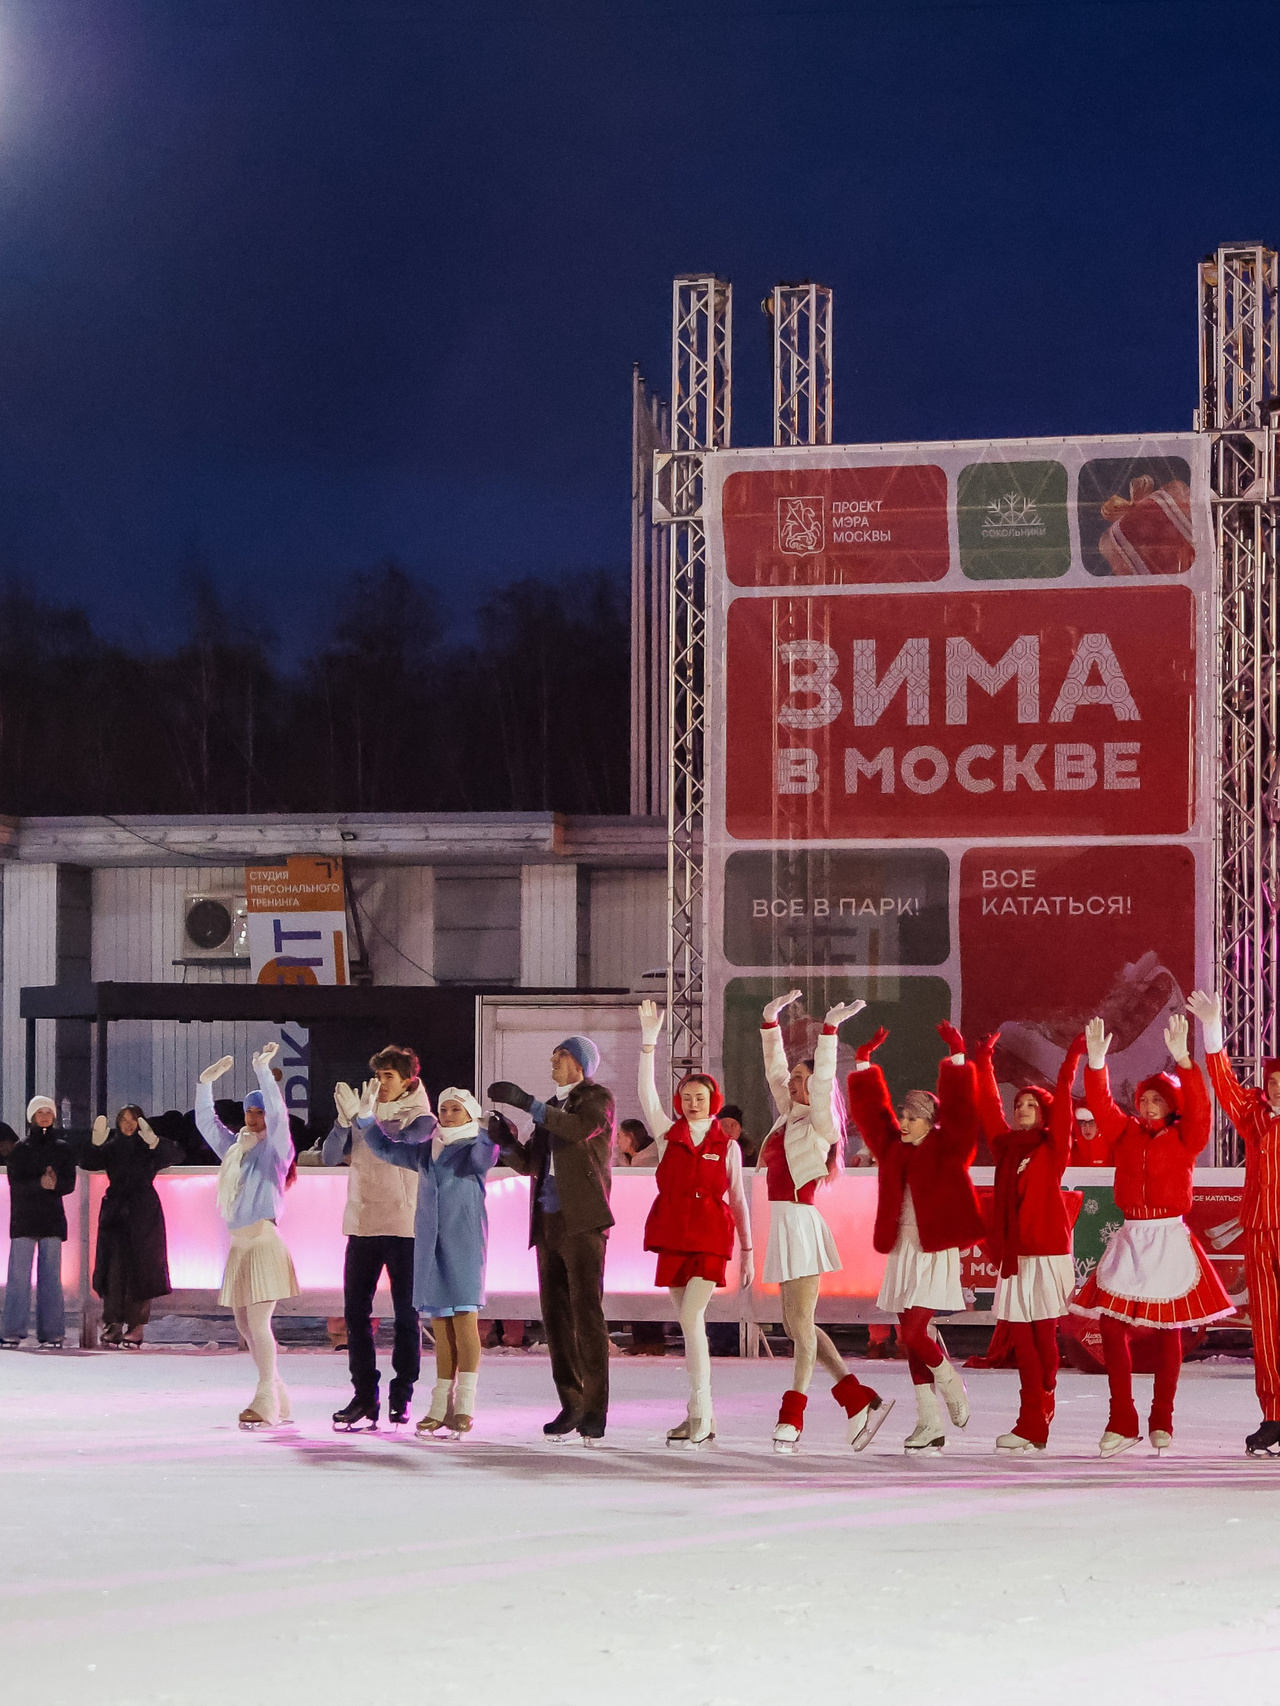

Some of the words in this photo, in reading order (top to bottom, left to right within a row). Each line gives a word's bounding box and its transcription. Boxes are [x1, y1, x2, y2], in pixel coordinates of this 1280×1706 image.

[831, 500, 883, 514] ПРОЕКТ
[832, 516, 870, 528] МЭРА
[833, 530, 891, 543] МОСКВЫ
[981, 528, 1046, 538] СОКОЛЬНИКИ
[777, 633, 1142, 729] ЗИМА
[777, 747, 820, 795] В
[844, 741, 1141, 795] МОСКВЕ
[250, 870, 289, 881] СТУДИЯ
[982, 869, 1036, 888] ВСЕ
[250, 883, 340, 894] ПЕРСОНАЛЬНОГО
[251, 898, 300, 907] ТРЕНИНГА
[752, 898, 804, 918] ВСЕ
[813, 898, 830, 917] В
[838, 897, 920, 917] ПАРК!
[982, 896, 1132, 916] КАТАТЬСЯ!
